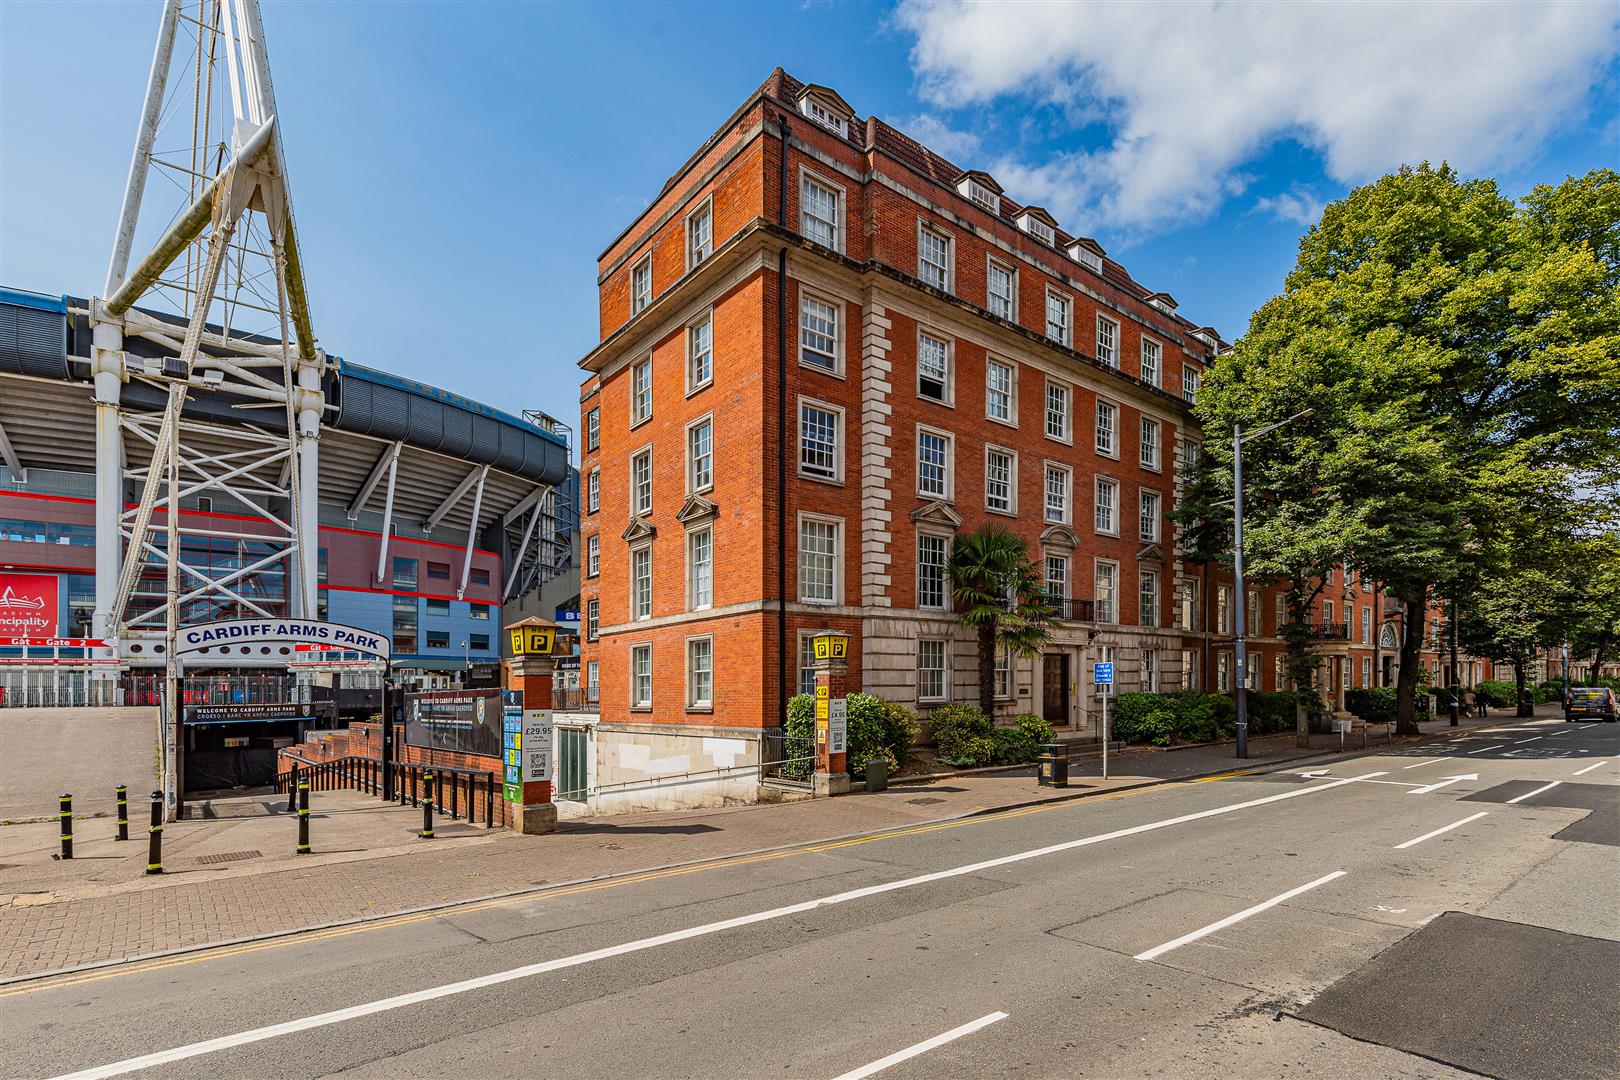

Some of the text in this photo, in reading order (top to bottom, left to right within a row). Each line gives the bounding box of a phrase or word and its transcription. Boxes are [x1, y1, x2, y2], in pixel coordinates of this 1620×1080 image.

[0, 617, 49, 628] ncipality
[187, 624, 380, 650] CARDIFF ARMS PARK
[534, 636, 545, 650] P
